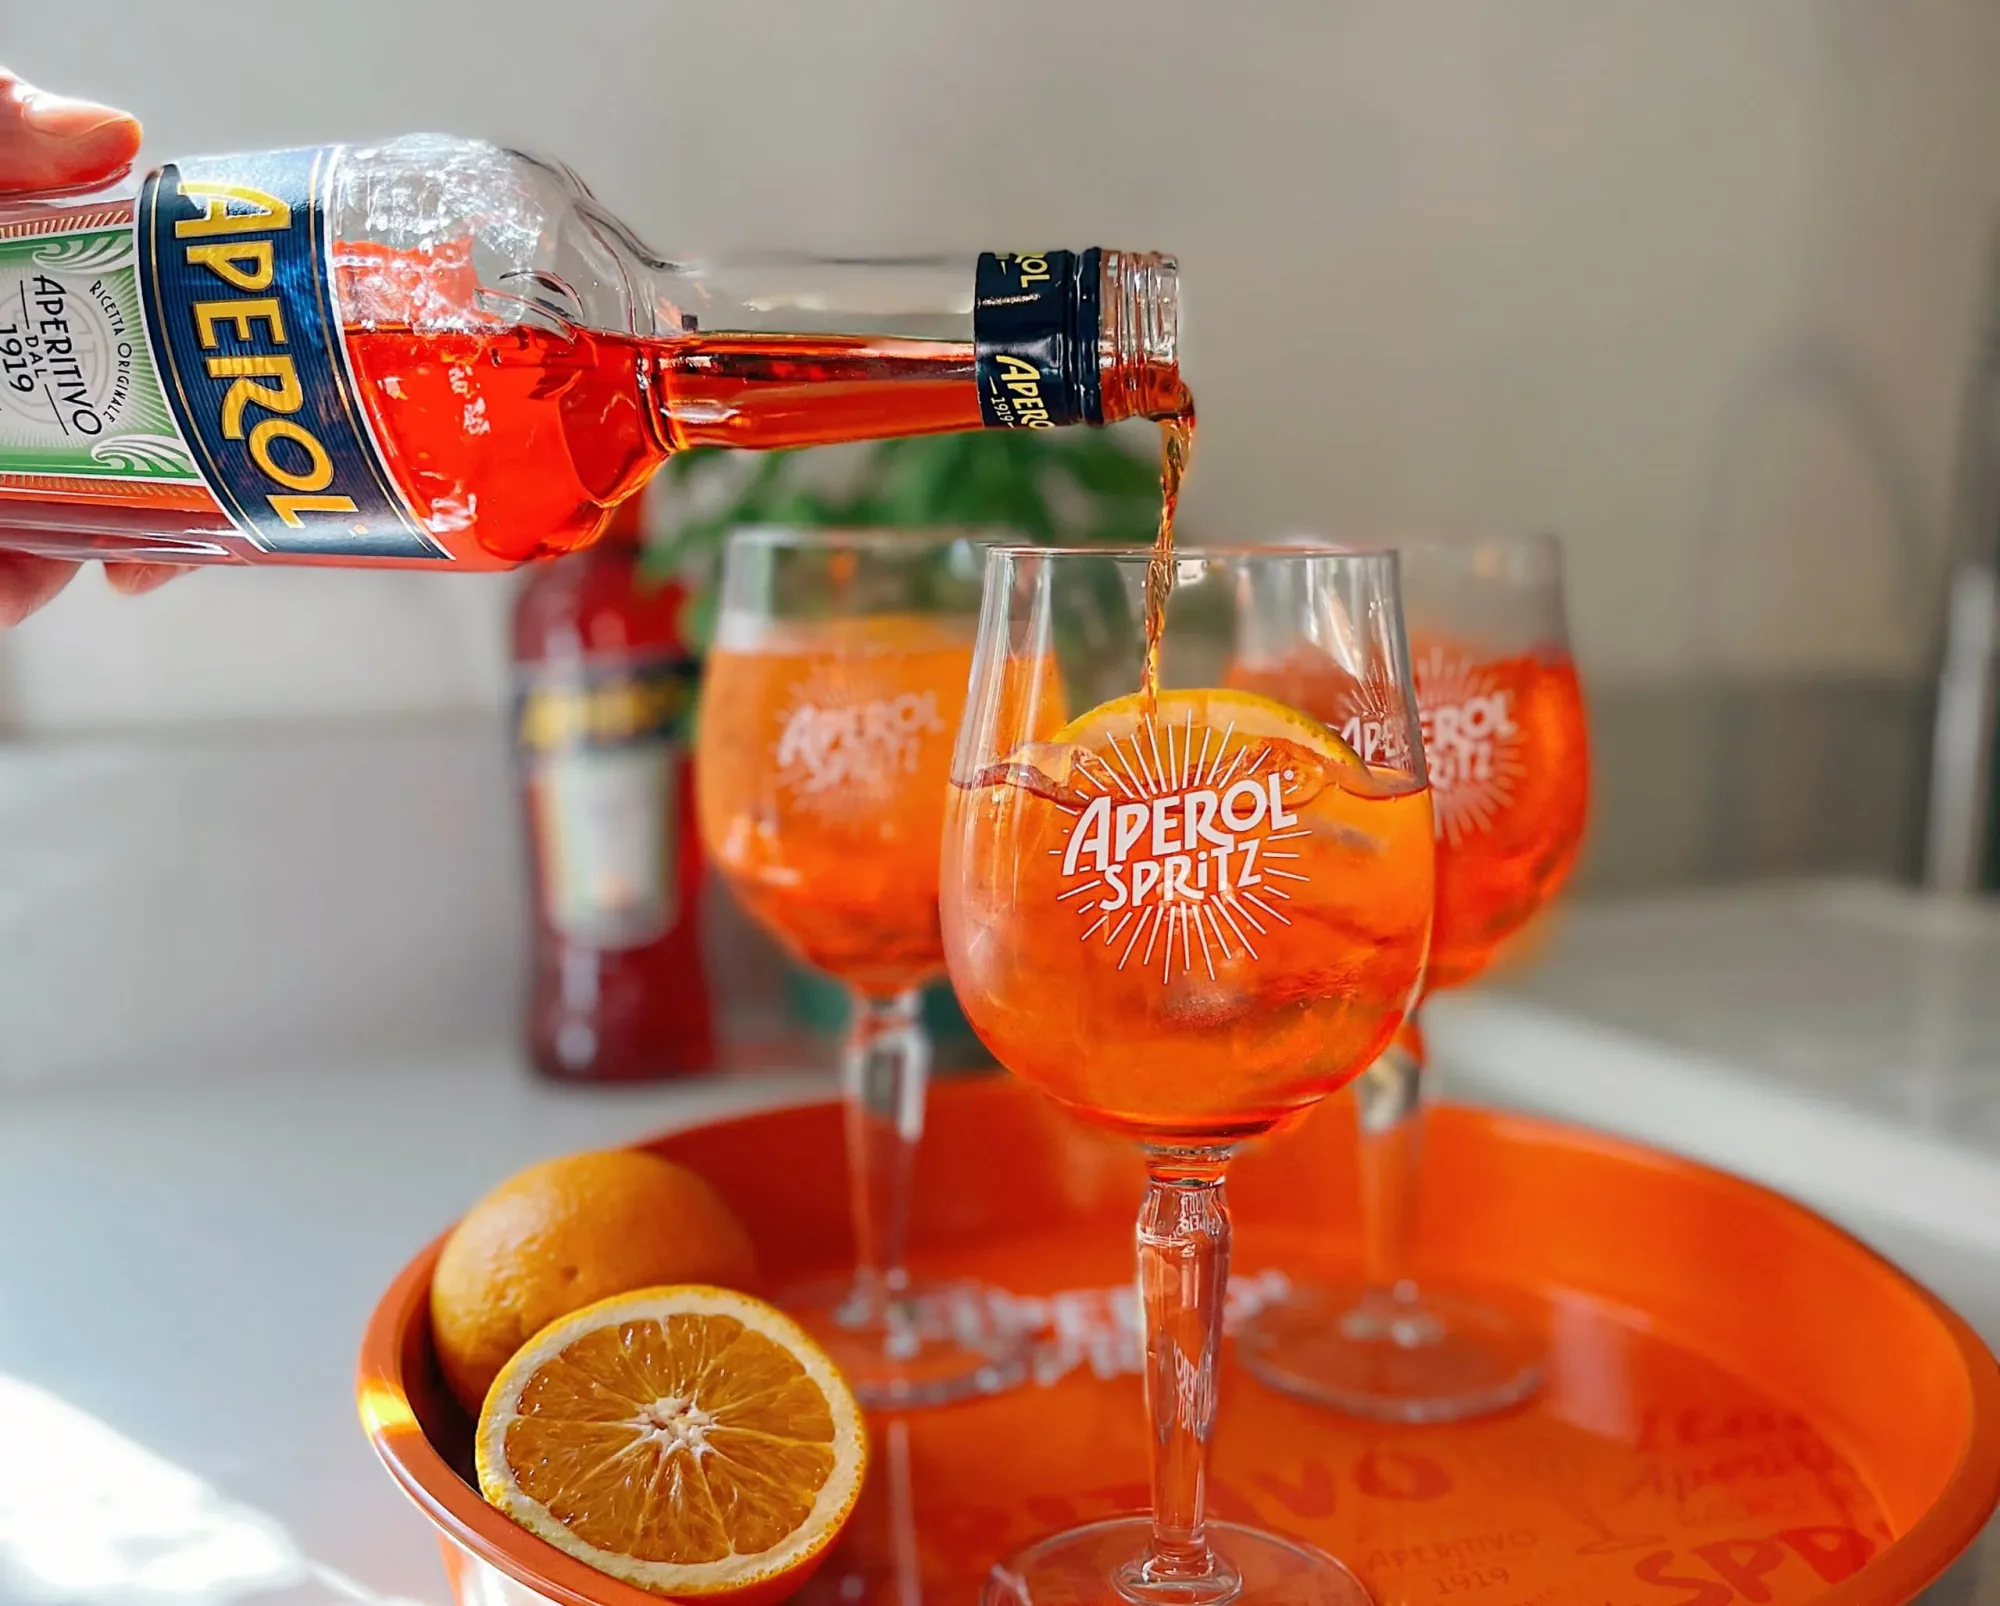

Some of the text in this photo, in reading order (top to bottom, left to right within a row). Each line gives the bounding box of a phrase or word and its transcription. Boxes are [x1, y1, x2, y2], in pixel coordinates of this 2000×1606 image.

[0, 323, 34, 393] 1919
[25, 335, 48, 379] DAL
[33, 275, 102, 435] APERITIVO
[89, 280, 132, 423] RICETTA ORIGINALE
[175, 181, 359, 530] APEROL
[990, 396, 1015, 421] 1919
[1062, 772, 1298, 876] APEROL
[1433, 1566, 1510, 1595] 1919
